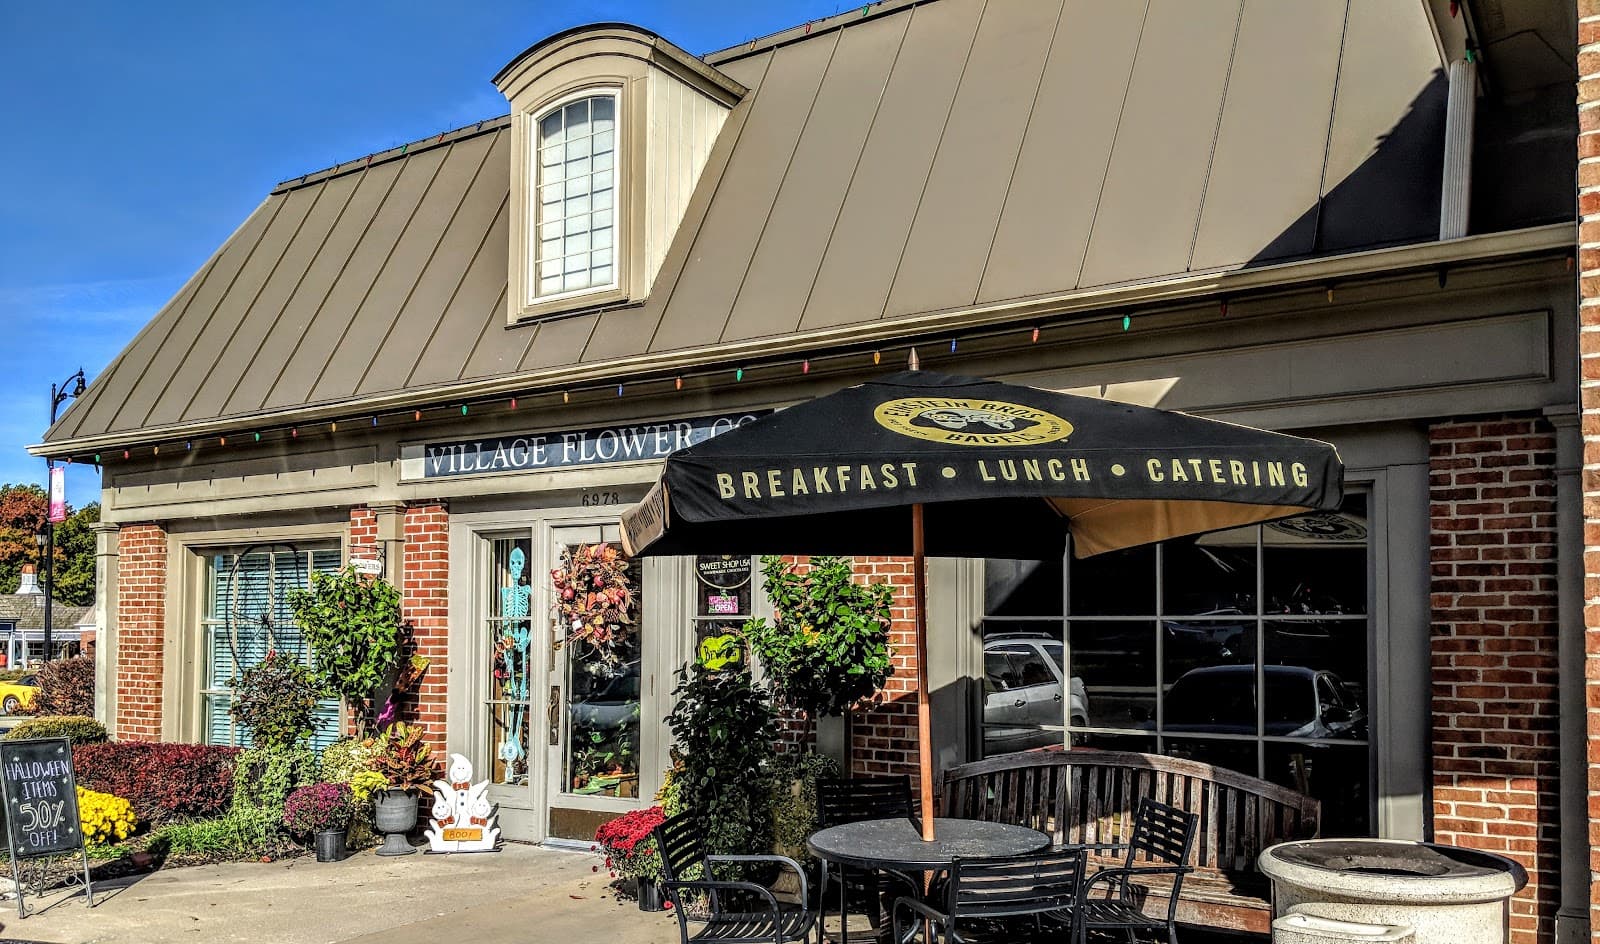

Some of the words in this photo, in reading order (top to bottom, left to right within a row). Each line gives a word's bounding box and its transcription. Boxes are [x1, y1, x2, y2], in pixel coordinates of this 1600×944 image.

[883, 400, 969, 417] EINSTEIN
[981, 402, 1044, 419] BROS
[428, 435, 548, 475] VILLAGE
[560, 422, 693, 463] FLOWER
[716, 462, 918, 500] BREAKFAST
[978, 458, 1092, 482] LUNCH
[1147, 458, 1309, 488] CATERING
[582, 492, 619, 507] 6978
[699, 561, 721, 571] SWEET
[722, 559, 739, 569] SHOP
[5, 760, 70, 780] HALLOWEEN
[22, 780, 58, 800] ITEMS
[19, 800, 66, 832] 50%
[29, 829, 57, 847] OFF!
